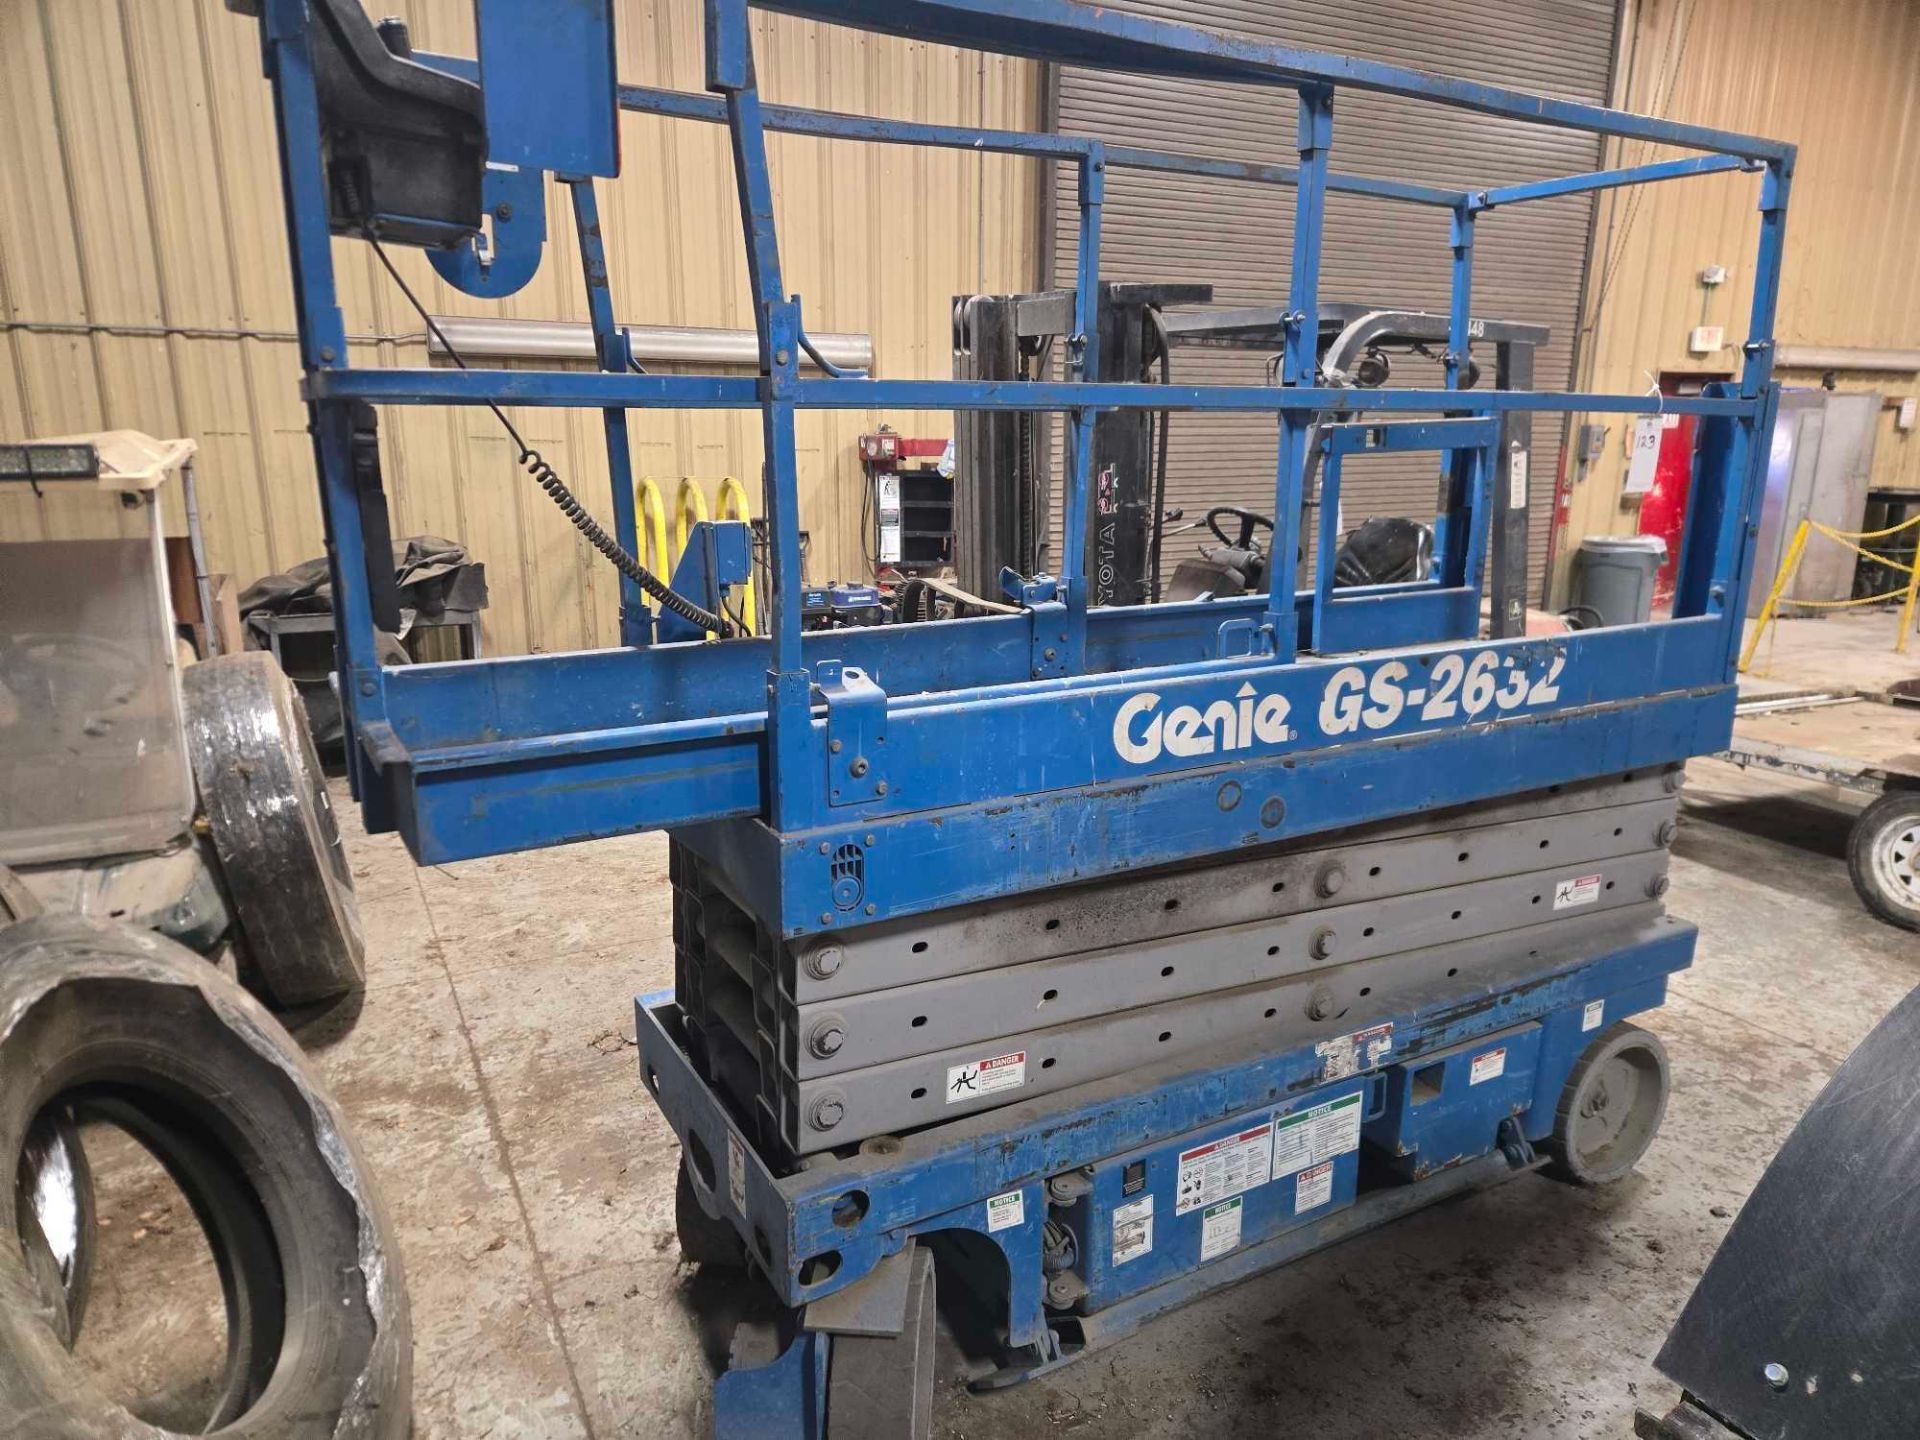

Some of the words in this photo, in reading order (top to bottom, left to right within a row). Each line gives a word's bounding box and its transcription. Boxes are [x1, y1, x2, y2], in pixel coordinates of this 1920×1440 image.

[1636, 434, 1656, 449] 123
[1098, 522, 1115, 606] YOTA
[1113, 681, 1291, 764] Genie
[1318, 648, 1567, 736] GS-2632
[991, 1055, 1019, 1069] DANGER
